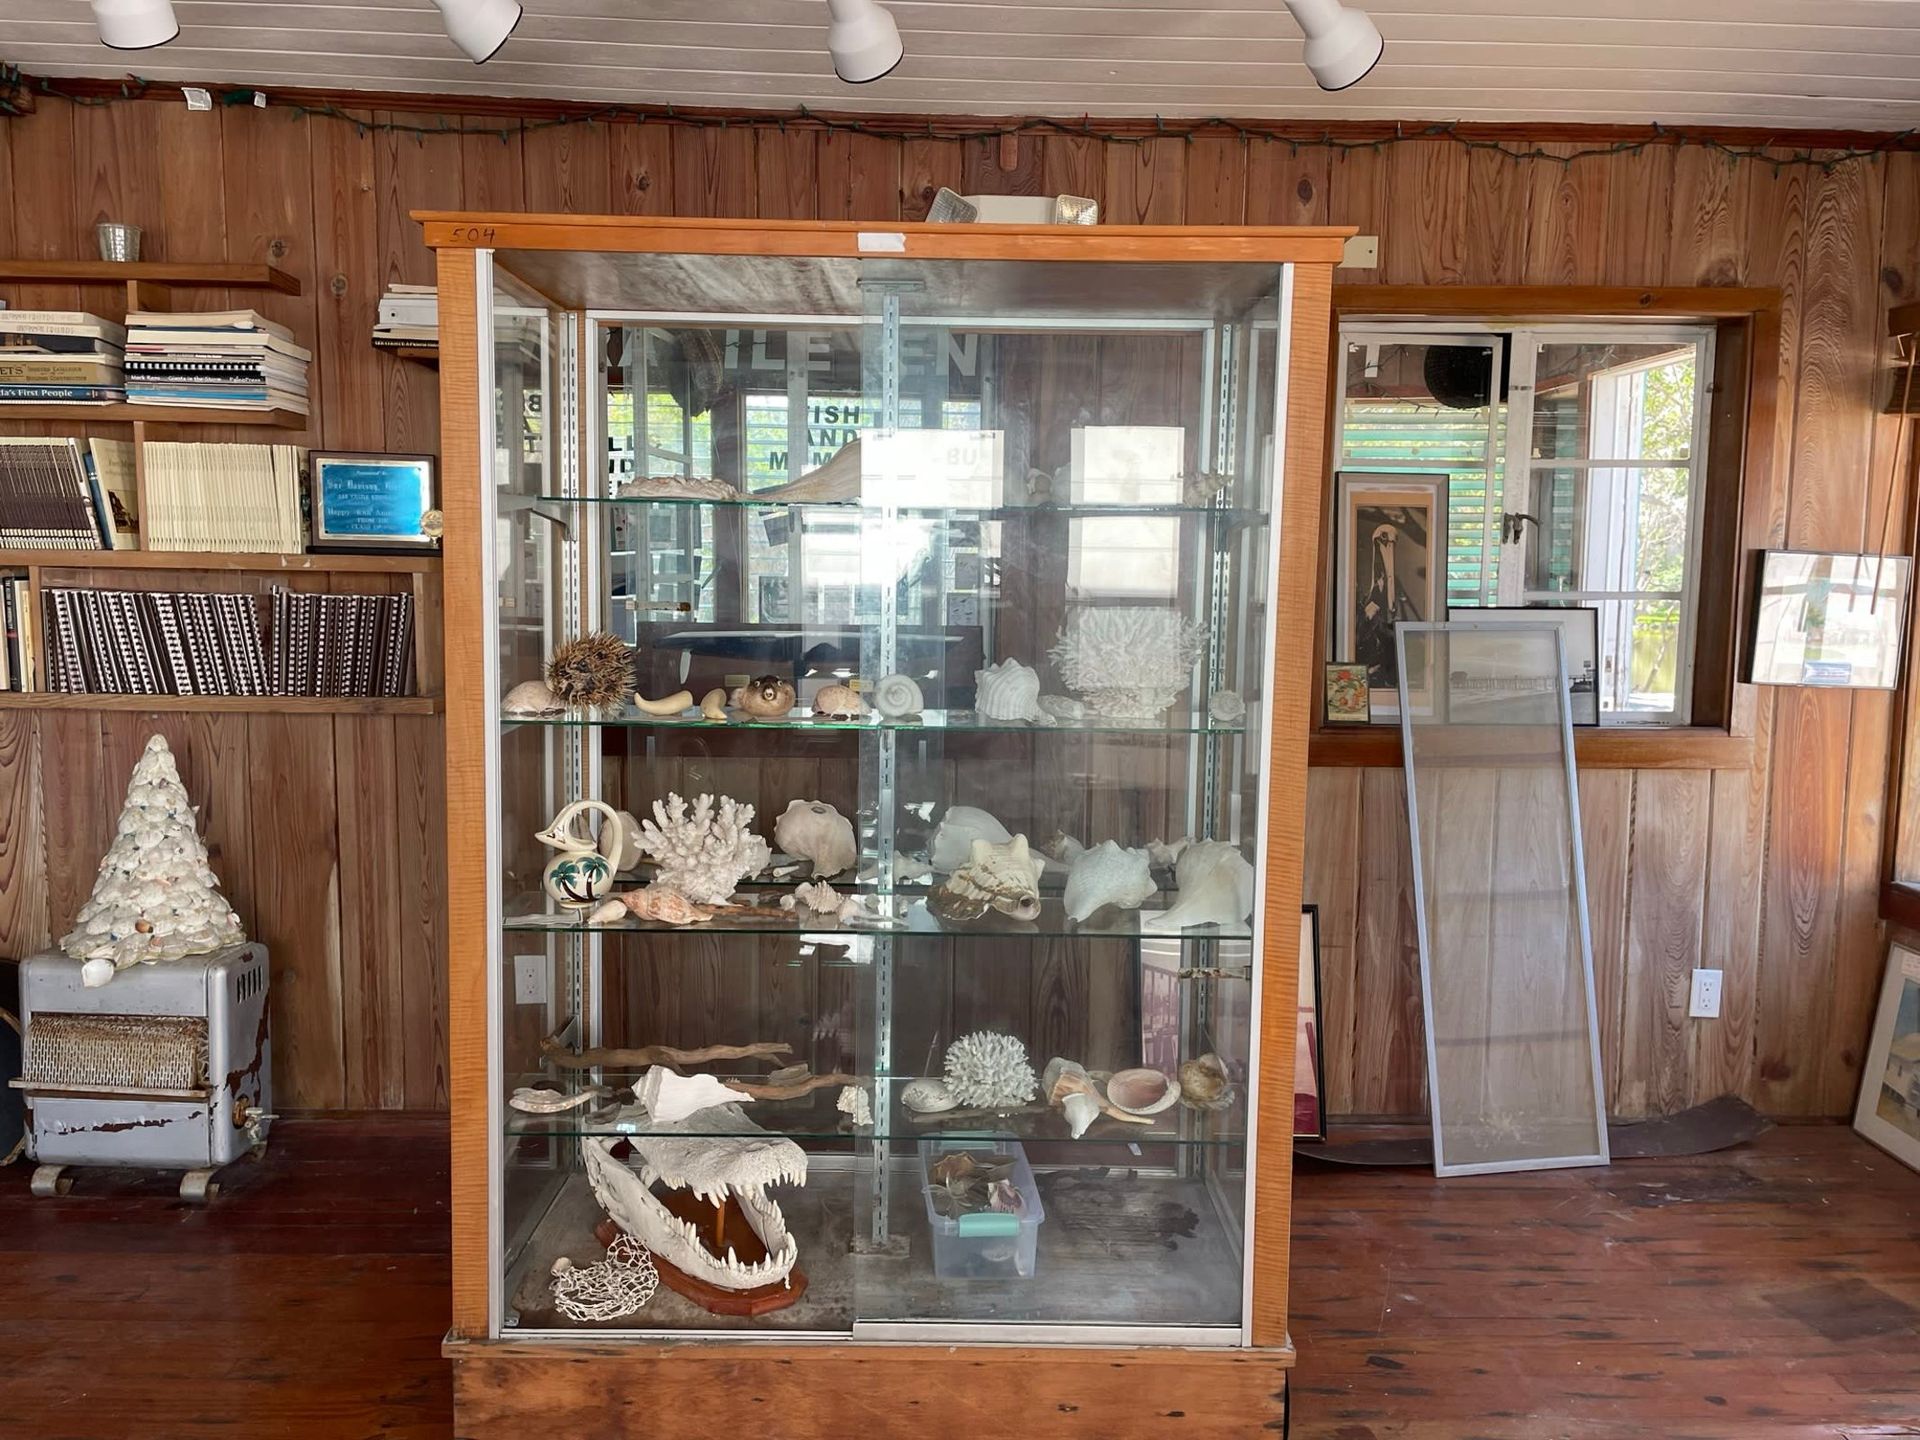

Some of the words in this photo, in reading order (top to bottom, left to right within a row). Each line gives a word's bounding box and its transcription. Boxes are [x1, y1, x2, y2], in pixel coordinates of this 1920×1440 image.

[450, 228, 495, 244] 504
[18, 389, 38, 397] First
[41, 389, 72, 398] People
[811, 405, 860, 425] ISH
